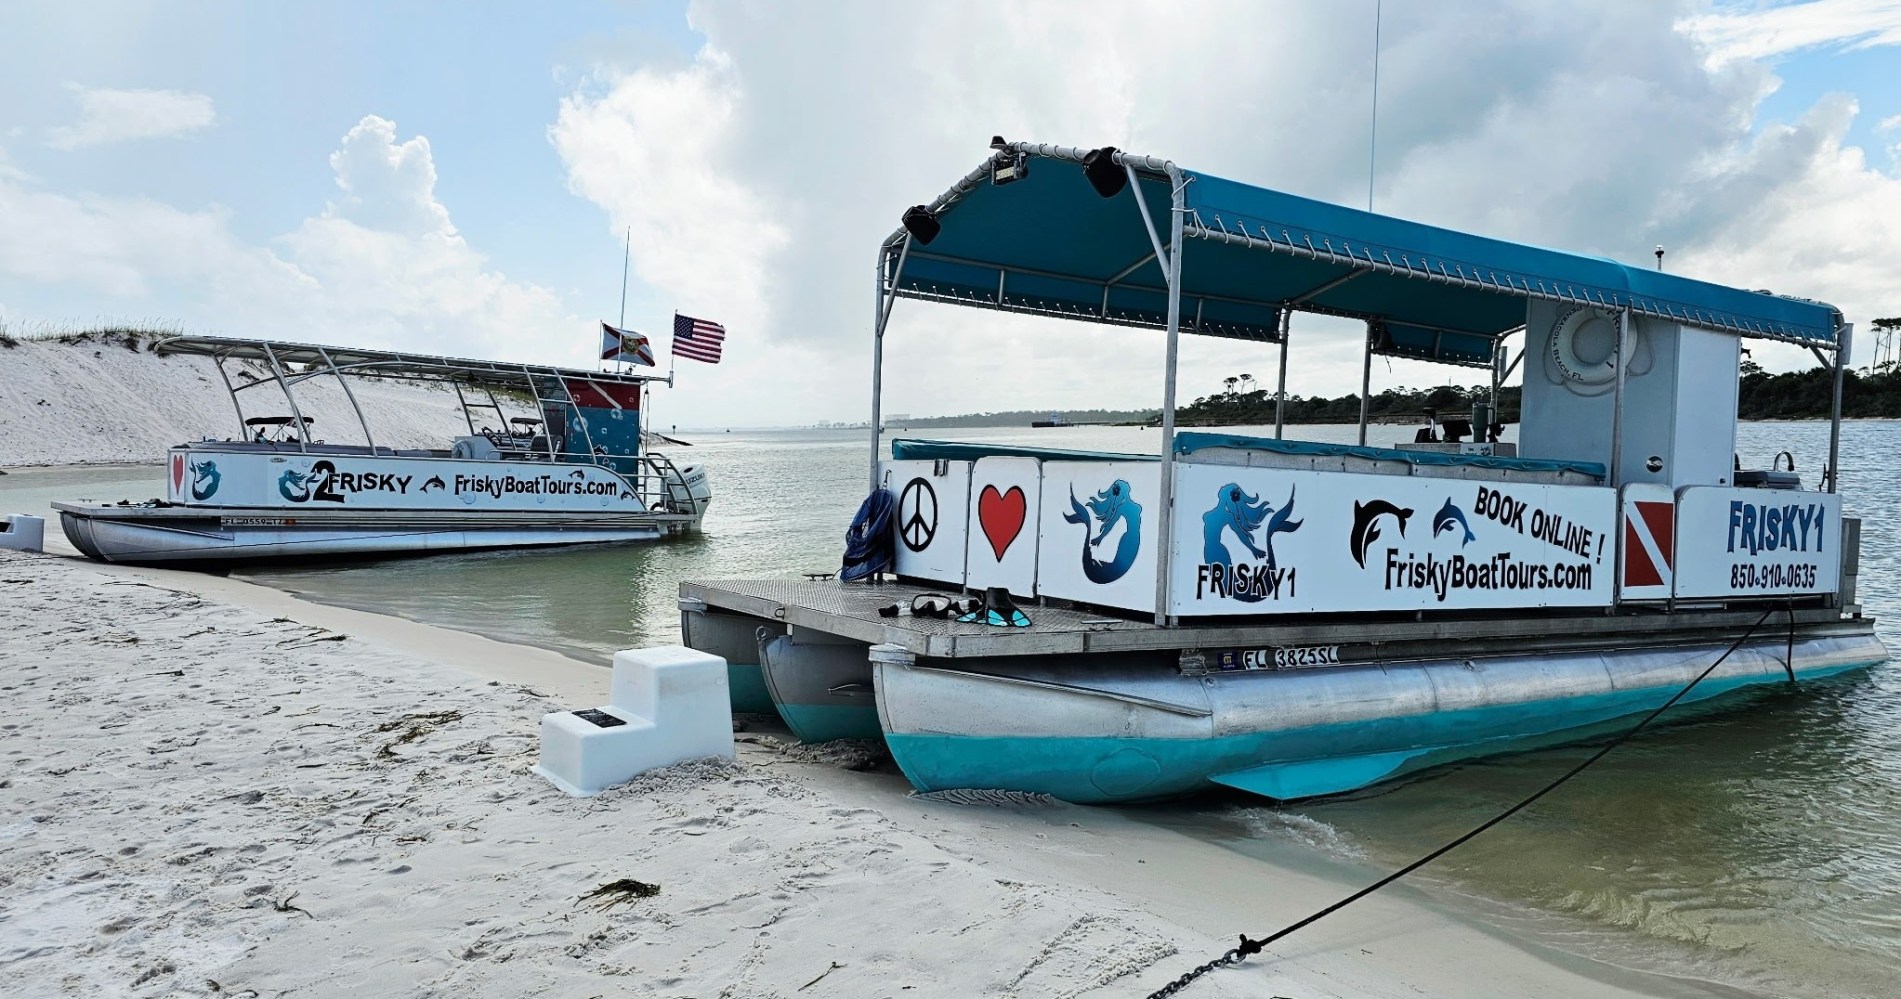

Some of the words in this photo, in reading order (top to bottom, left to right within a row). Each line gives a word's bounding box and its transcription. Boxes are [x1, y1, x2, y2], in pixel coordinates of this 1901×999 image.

[1572, 372, 1584, 380] FL
[454, 474, 617, 499] FriskyBoatTours.com
[683, 473, 705, 485] UZUKI
[1474, 485, 1528, 534] BOOK
[1530, 508, 1592, 559] ONLINE
[1727, 500, 1825, 556] FRISKY1
[1196, 562, 1296, 600] FRISKY1
[1385, 548, 1592, 602] FriskyBoatTours.com
[1244, 651, 1267, 669] FL
[1277, 647, 1338, 667] 3825SL
